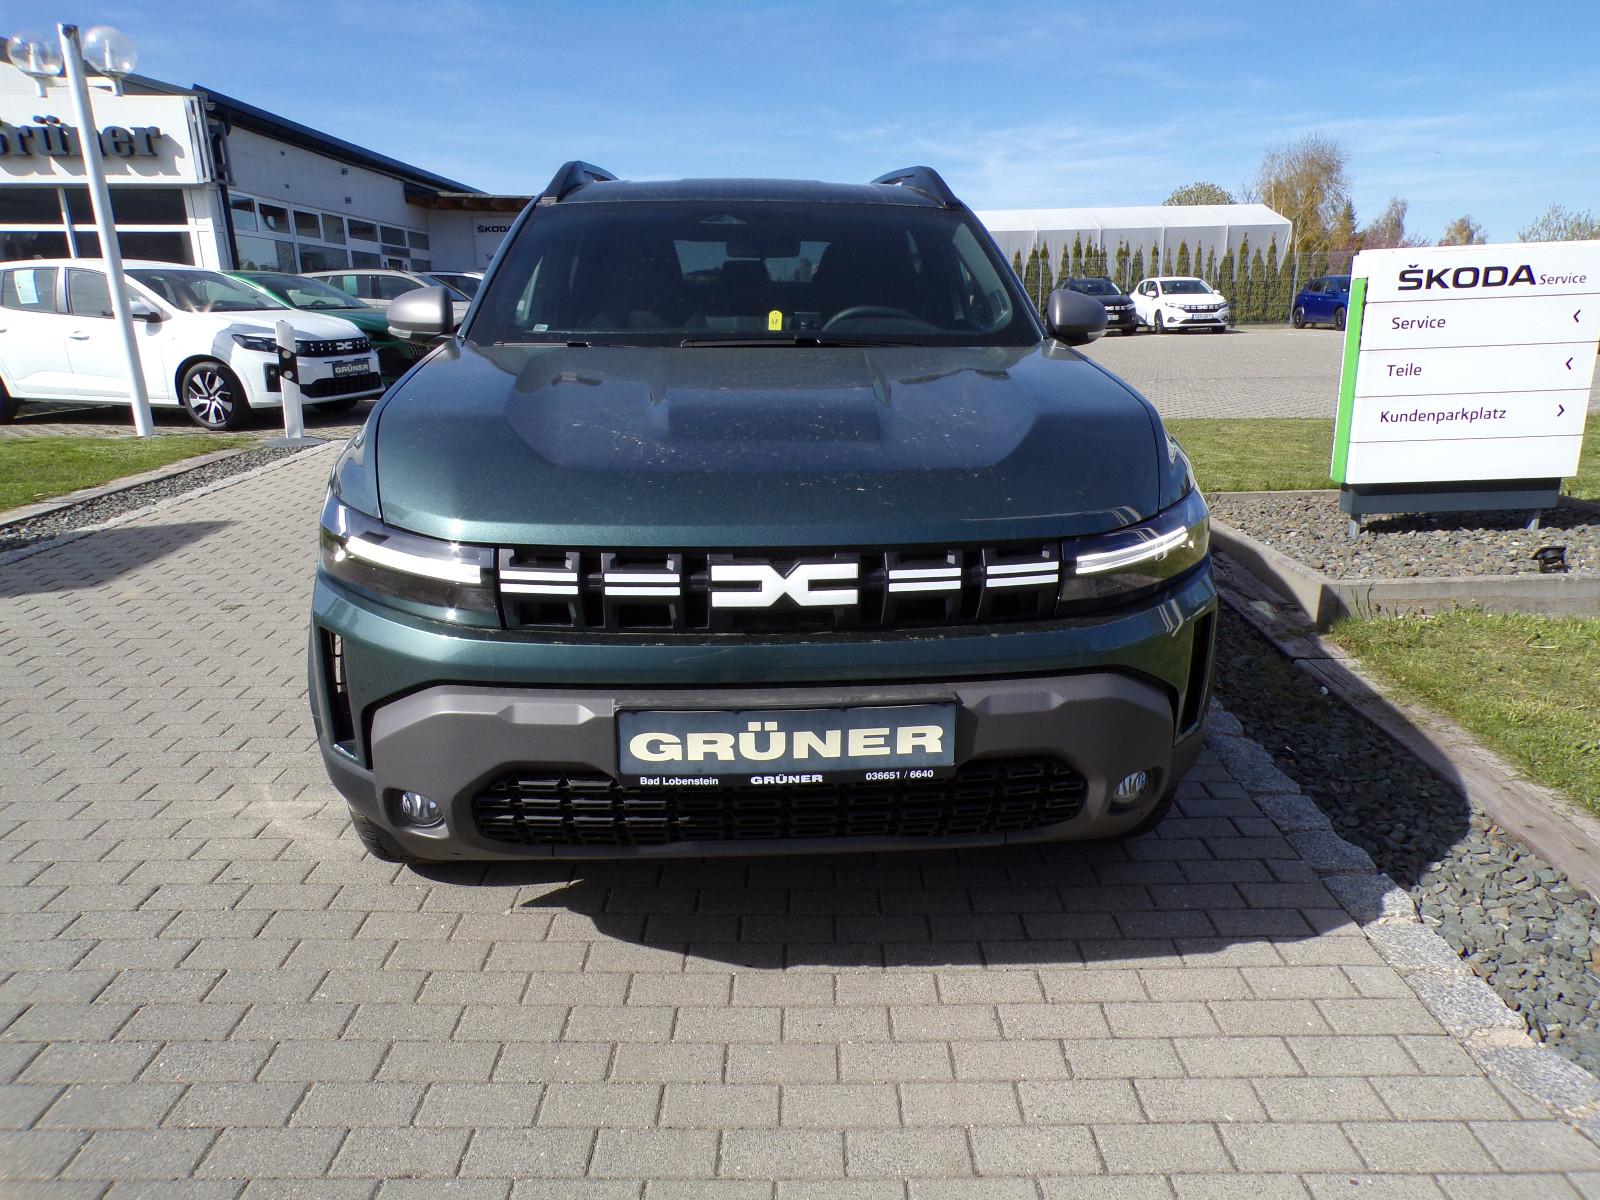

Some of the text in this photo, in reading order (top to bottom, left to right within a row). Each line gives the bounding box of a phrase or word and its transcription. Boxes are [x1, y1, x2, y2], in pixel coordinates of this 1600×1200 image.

[1398, 264, 1587, 291] ŠKODA Service
[1391, 315, 1446, 330] Service
[1387, 362, 1422, 377] Teile
[1380, 406, 1507, 425] Kundenparkplatz
[630, 721, 944, 762] GRÜNER
[639, 776, 719, 786] Bad Lobenstein
[750, 774, 823, 785] GRÜNER
[865, 772, 900, 781] 036651
[909, 770, 934, 779] 6640
